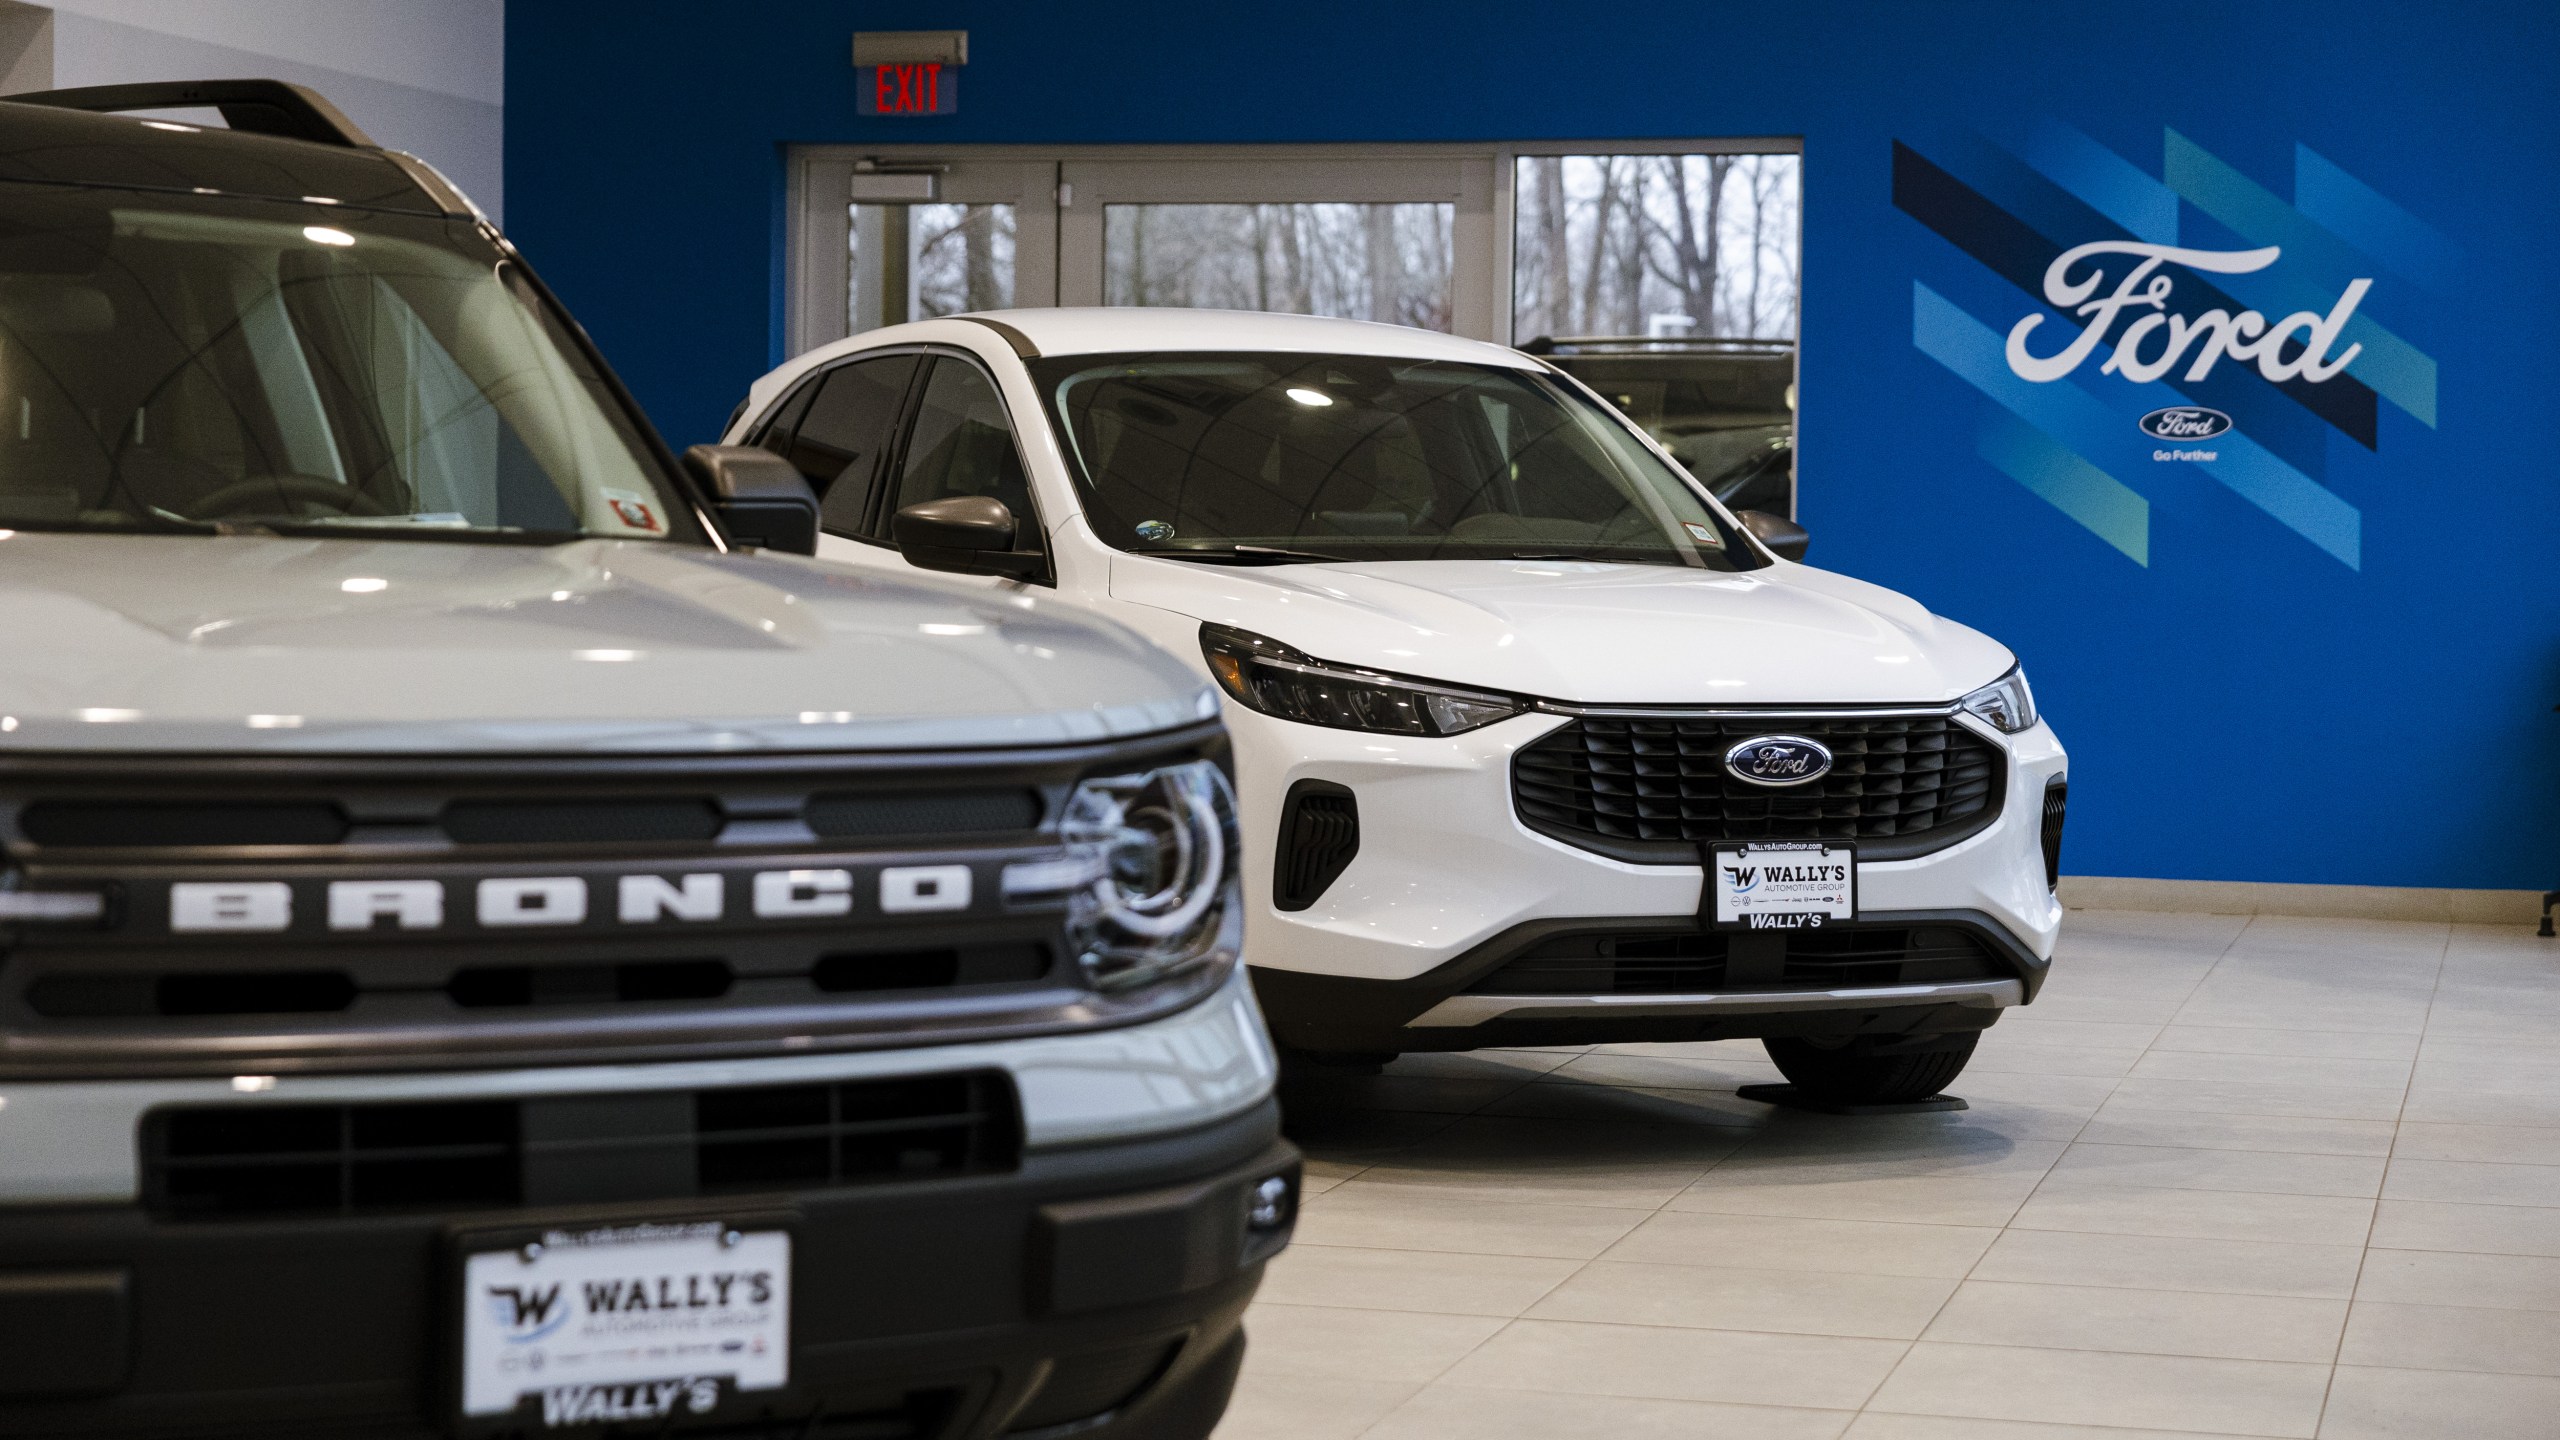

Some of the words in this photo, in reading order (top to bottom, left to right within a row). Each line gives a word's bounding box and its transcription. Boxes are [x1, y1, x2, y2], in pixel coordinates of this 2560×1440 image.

[877, 64, 941, 113] EXIT
[2005, 240, 2373, 383] Ford
[2156, 409, 2216, 435] Ford
[2153, 449, 2171, 462] Go
[2172, 449, 2218, 462] Further
[1752, 746, 1810, 774] Ford
[1764, 865, 1845, 883] WALLY'S
[1764, 884, 1815, 893] AUTOMOTIVE
[1817, 883, 1845, 892] GROUP
[170, 864, 975, 932] BRONCO
[1750, 913, 1822, 929] WALLY'S
[581, 1270, 772, 1314] WALLY'S
[542, 1377, 720, 1429] WALLY'S
